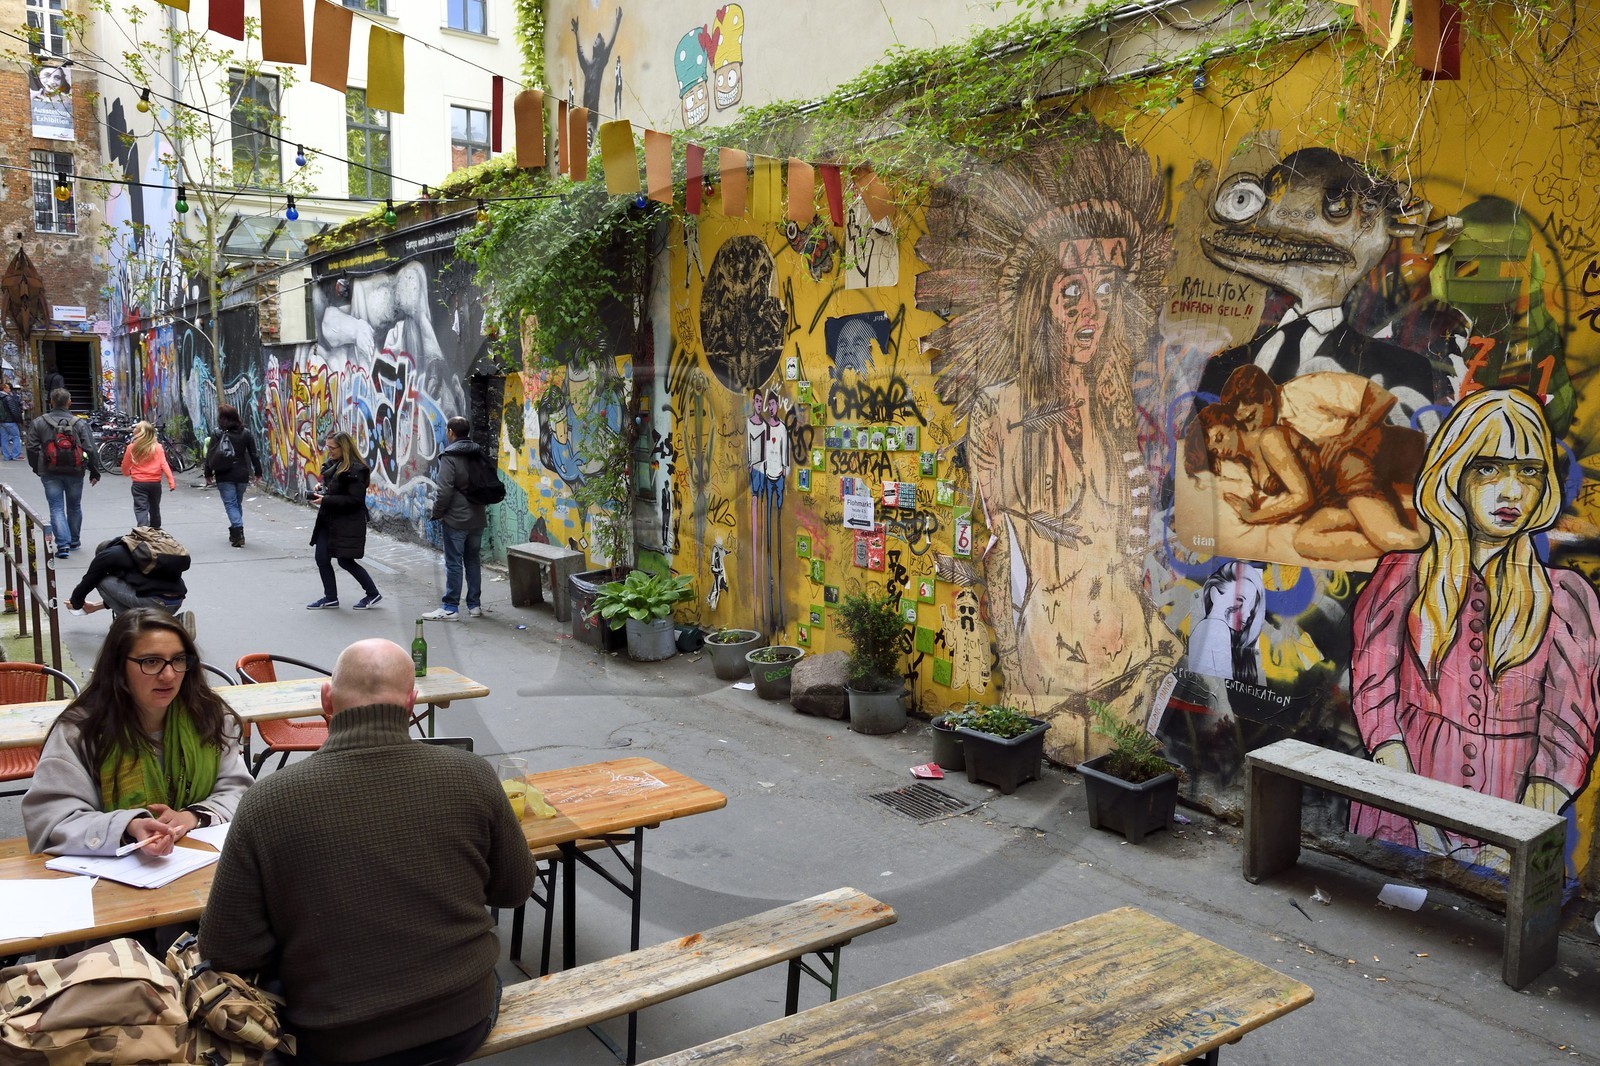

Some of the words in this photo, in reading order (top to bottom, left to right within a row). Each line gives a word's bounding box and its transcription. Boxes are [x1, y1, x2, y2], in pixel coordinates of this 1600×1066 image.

[36, 115, 70, 126] Exhibition
[1171, 300, 1213, 315] EINFACH
[1217, 303, 1254, 320] GEIL!!
[847, 499, 872, 509] Flohmarkt
[1192, 535, 1216, 547] tian
